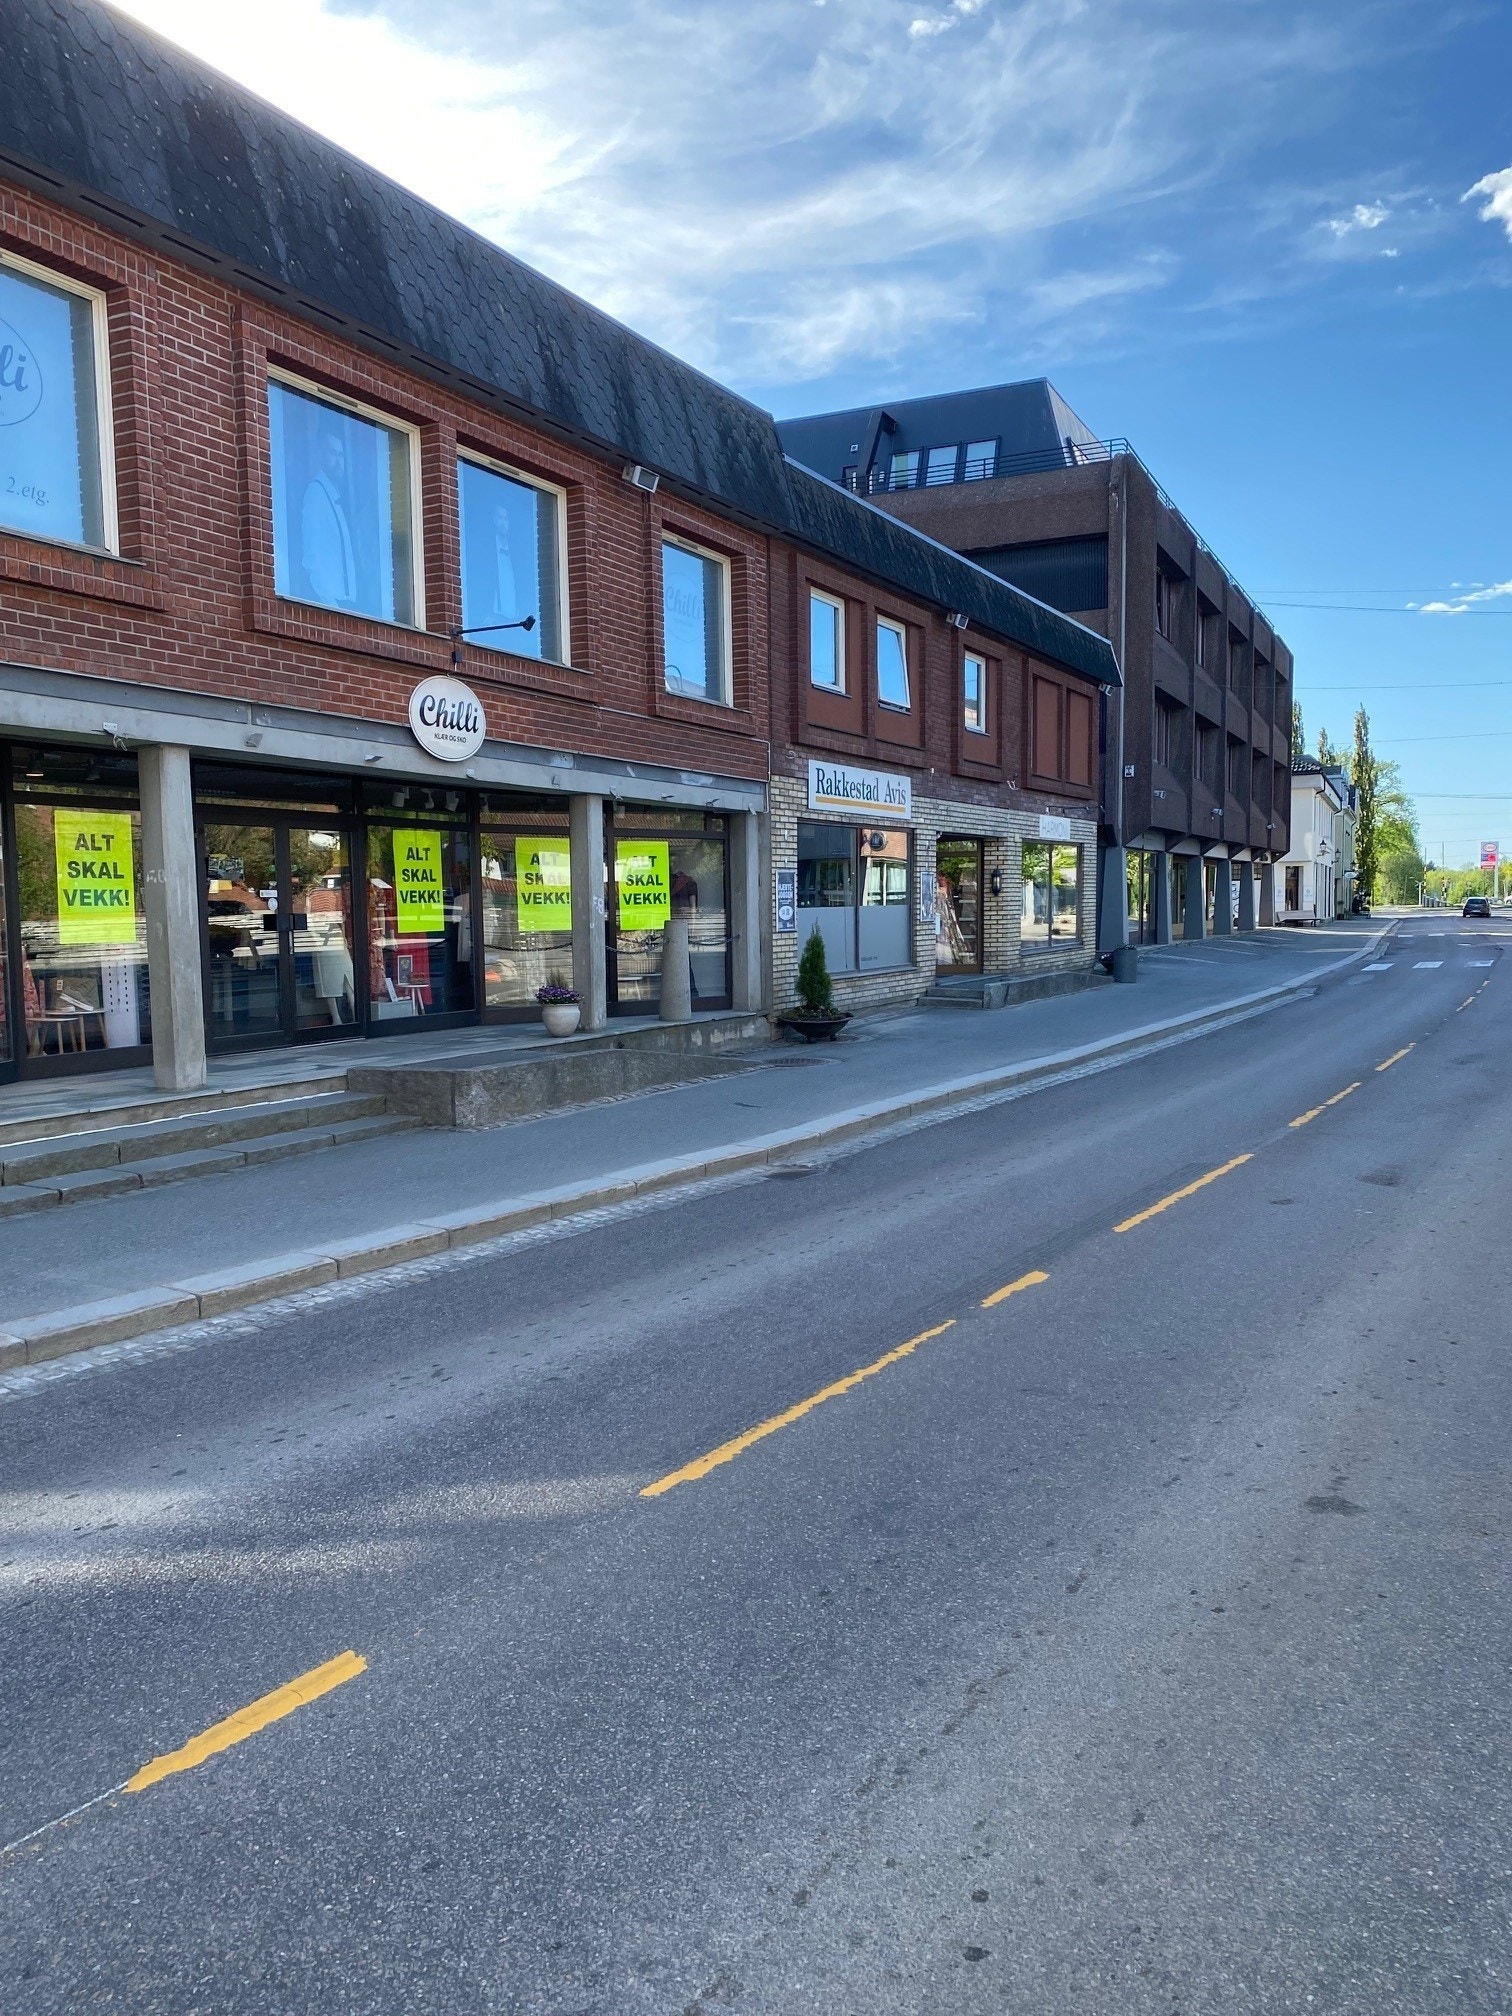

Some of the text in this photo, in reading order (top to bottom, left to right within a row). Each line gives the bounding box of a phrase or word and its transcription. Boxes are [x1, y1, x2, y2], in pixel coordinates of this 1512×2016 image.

[6, 476, 50, 507] 2.etg.
[419, 694, 479, 733] Chilli
[815, 767, 907, 806] Rakkestad Avis
[75, 833, 115, 852] ALT
[406, 846, 430, 861] ALT
[530, 852, 560, 867] ALT
[631, 854, 658, 868] ALT
[67, 860, 125, 879] SKAL
[402, 868, 437, 883] SKAL
[525, 871, 569, 886] SKAL
[625, 873, 664, 887] SKAL
[62, 888, 130, 907] VEKK!
[399, 889, 441, 904] VEKK!
[521, 892, 570, 905] VEKK!
[623, 892, 668, 906] VEKK!
